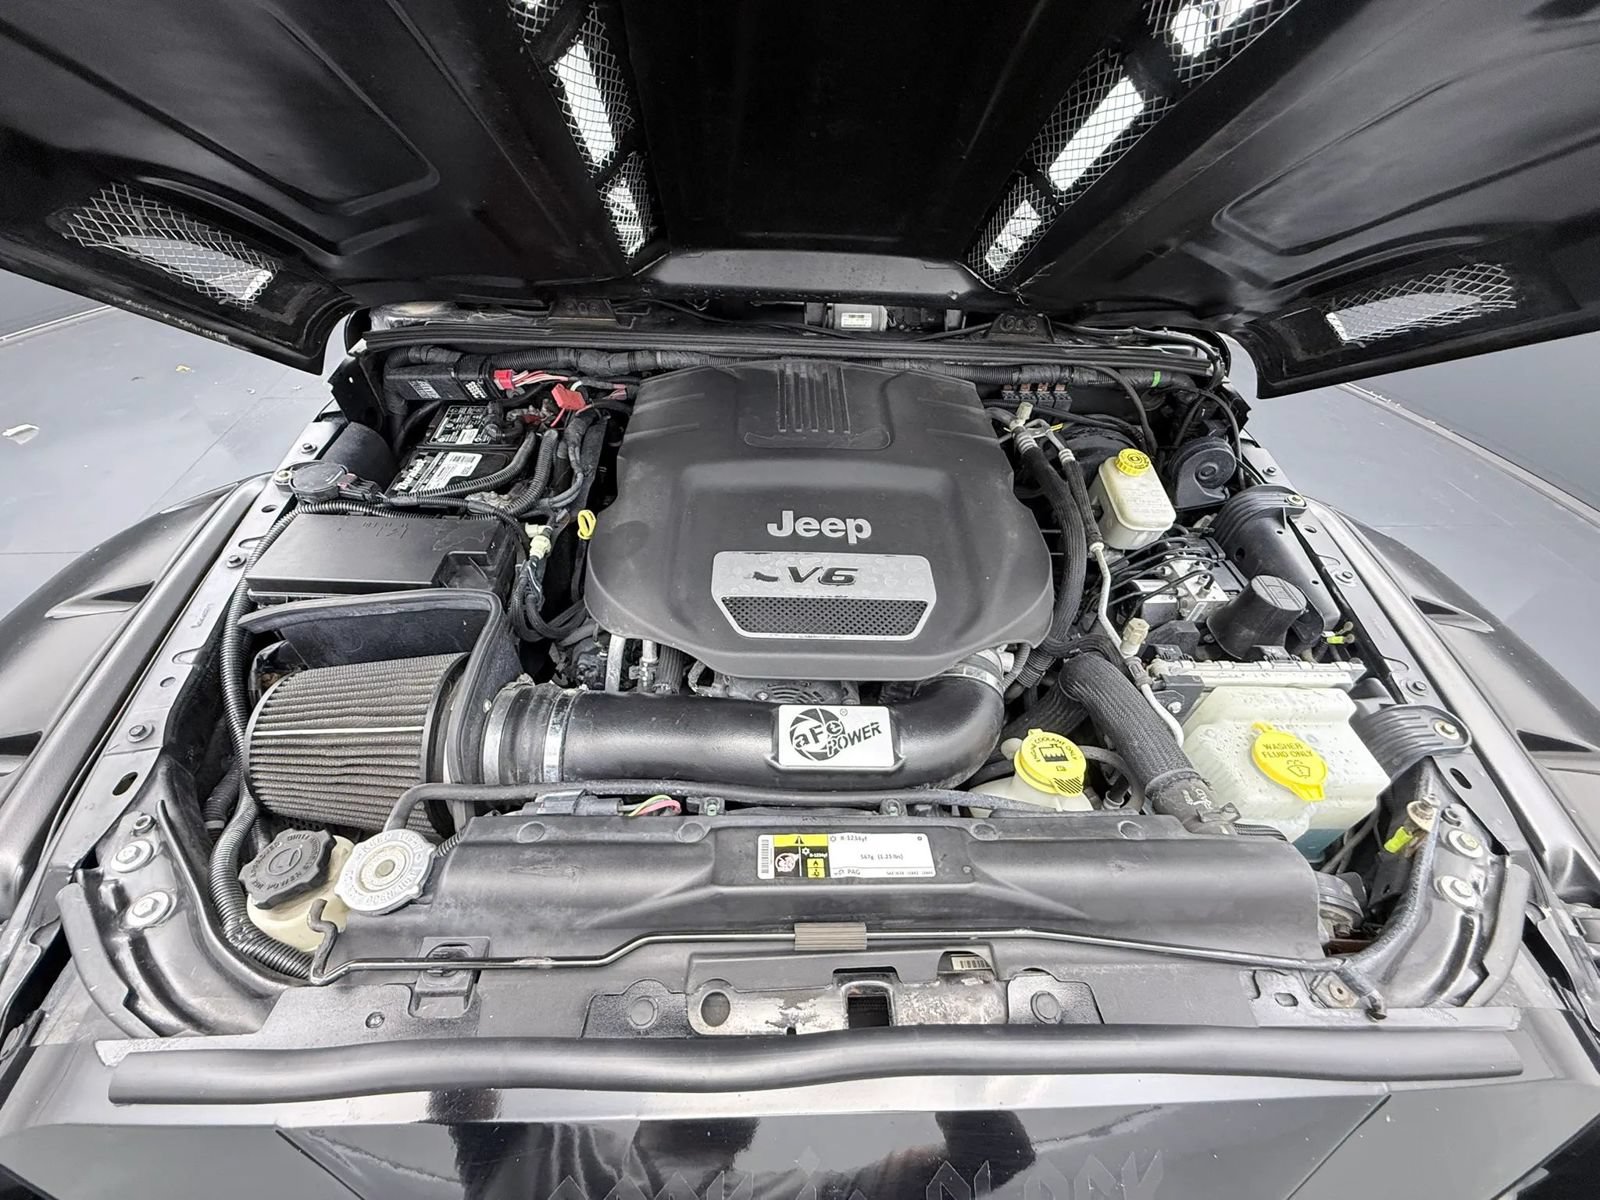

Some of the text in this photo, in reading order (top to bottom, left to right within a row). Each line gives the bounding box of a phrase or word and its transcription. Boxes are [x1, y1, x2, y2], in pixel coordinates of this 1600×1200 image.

[767, 510, 872, 544] Jeep
[788, 566, 858, 586] V6
[794, 721, 842, 748] aFe
[826, 721, 882, 757] POWER
[1262, 742, 1303, 750] WASHER
[1261, 749, 1312, 758] FLUID ONLY
